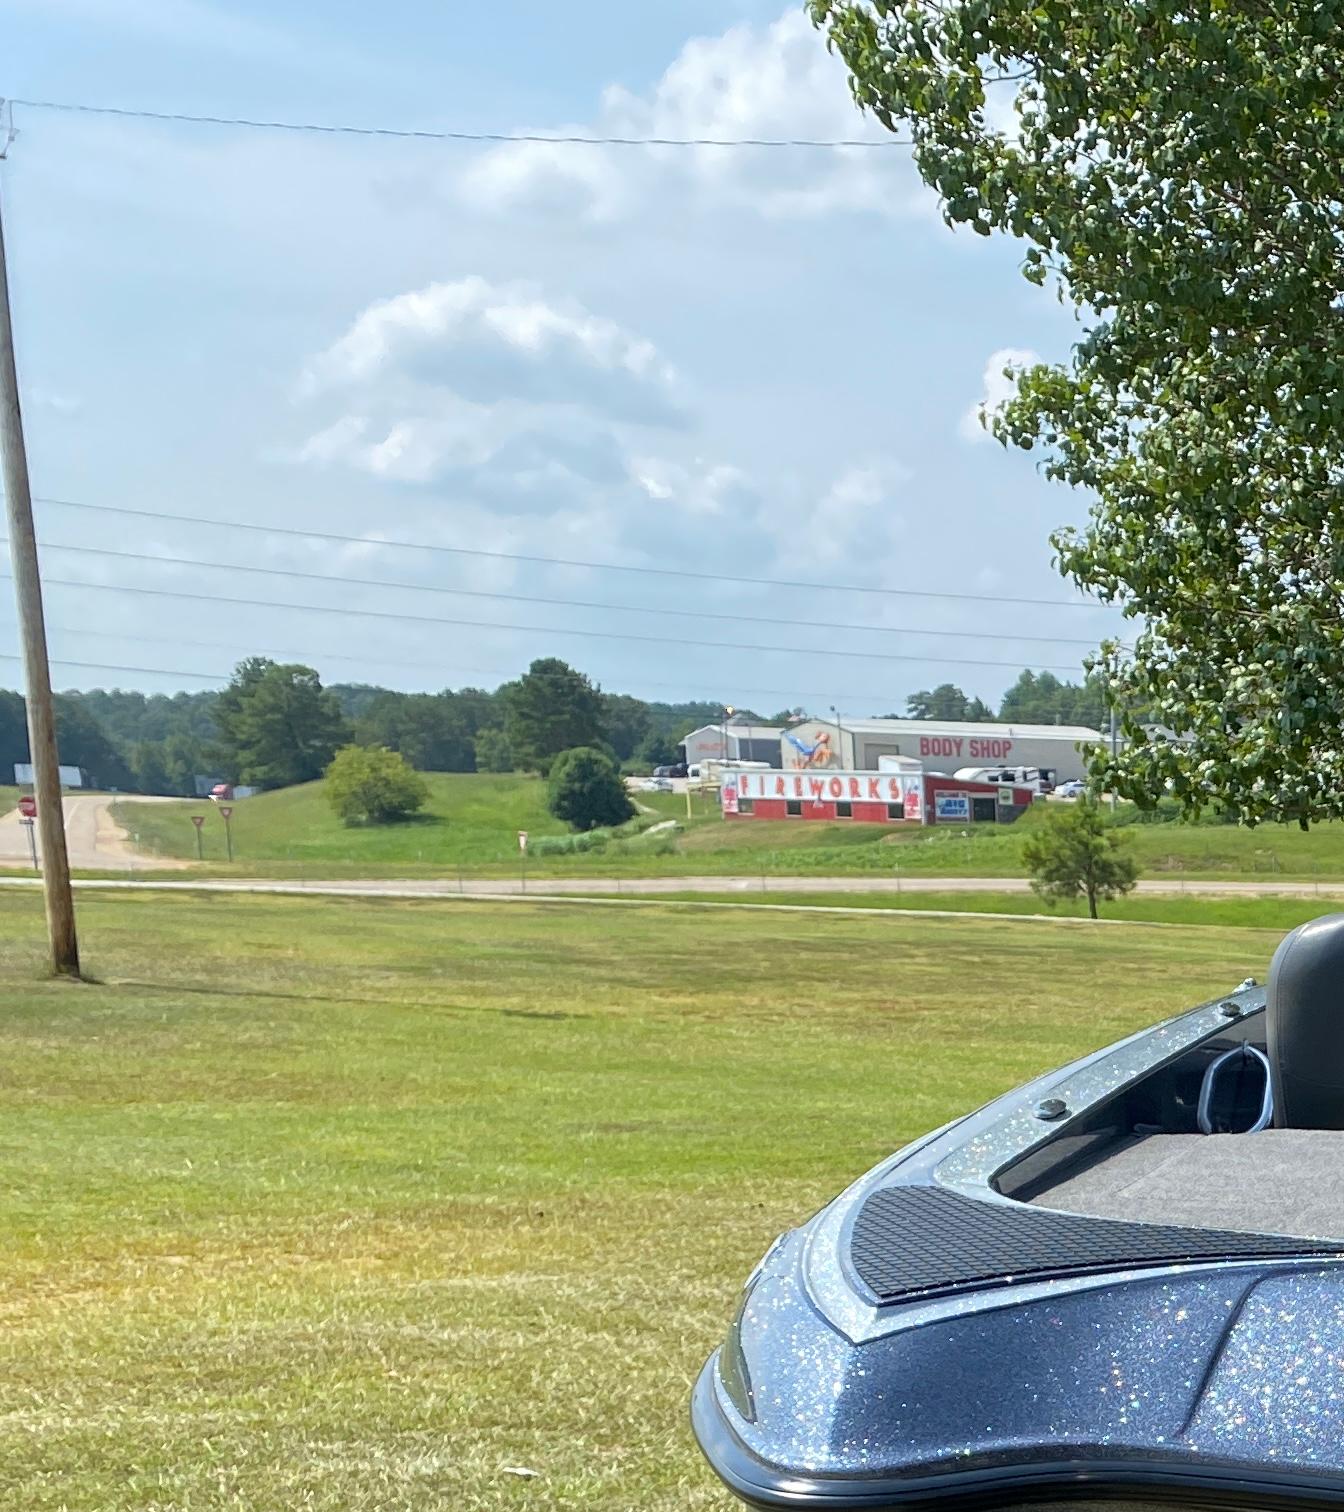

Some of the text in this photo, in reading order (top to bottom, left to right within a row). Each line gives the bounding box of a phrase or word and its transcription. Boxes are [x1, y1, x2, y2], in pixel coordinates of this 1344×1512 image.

[920, 737, 1012, 759] BODY SHOP
[740, 775, 899, 799] FIREWORKS
